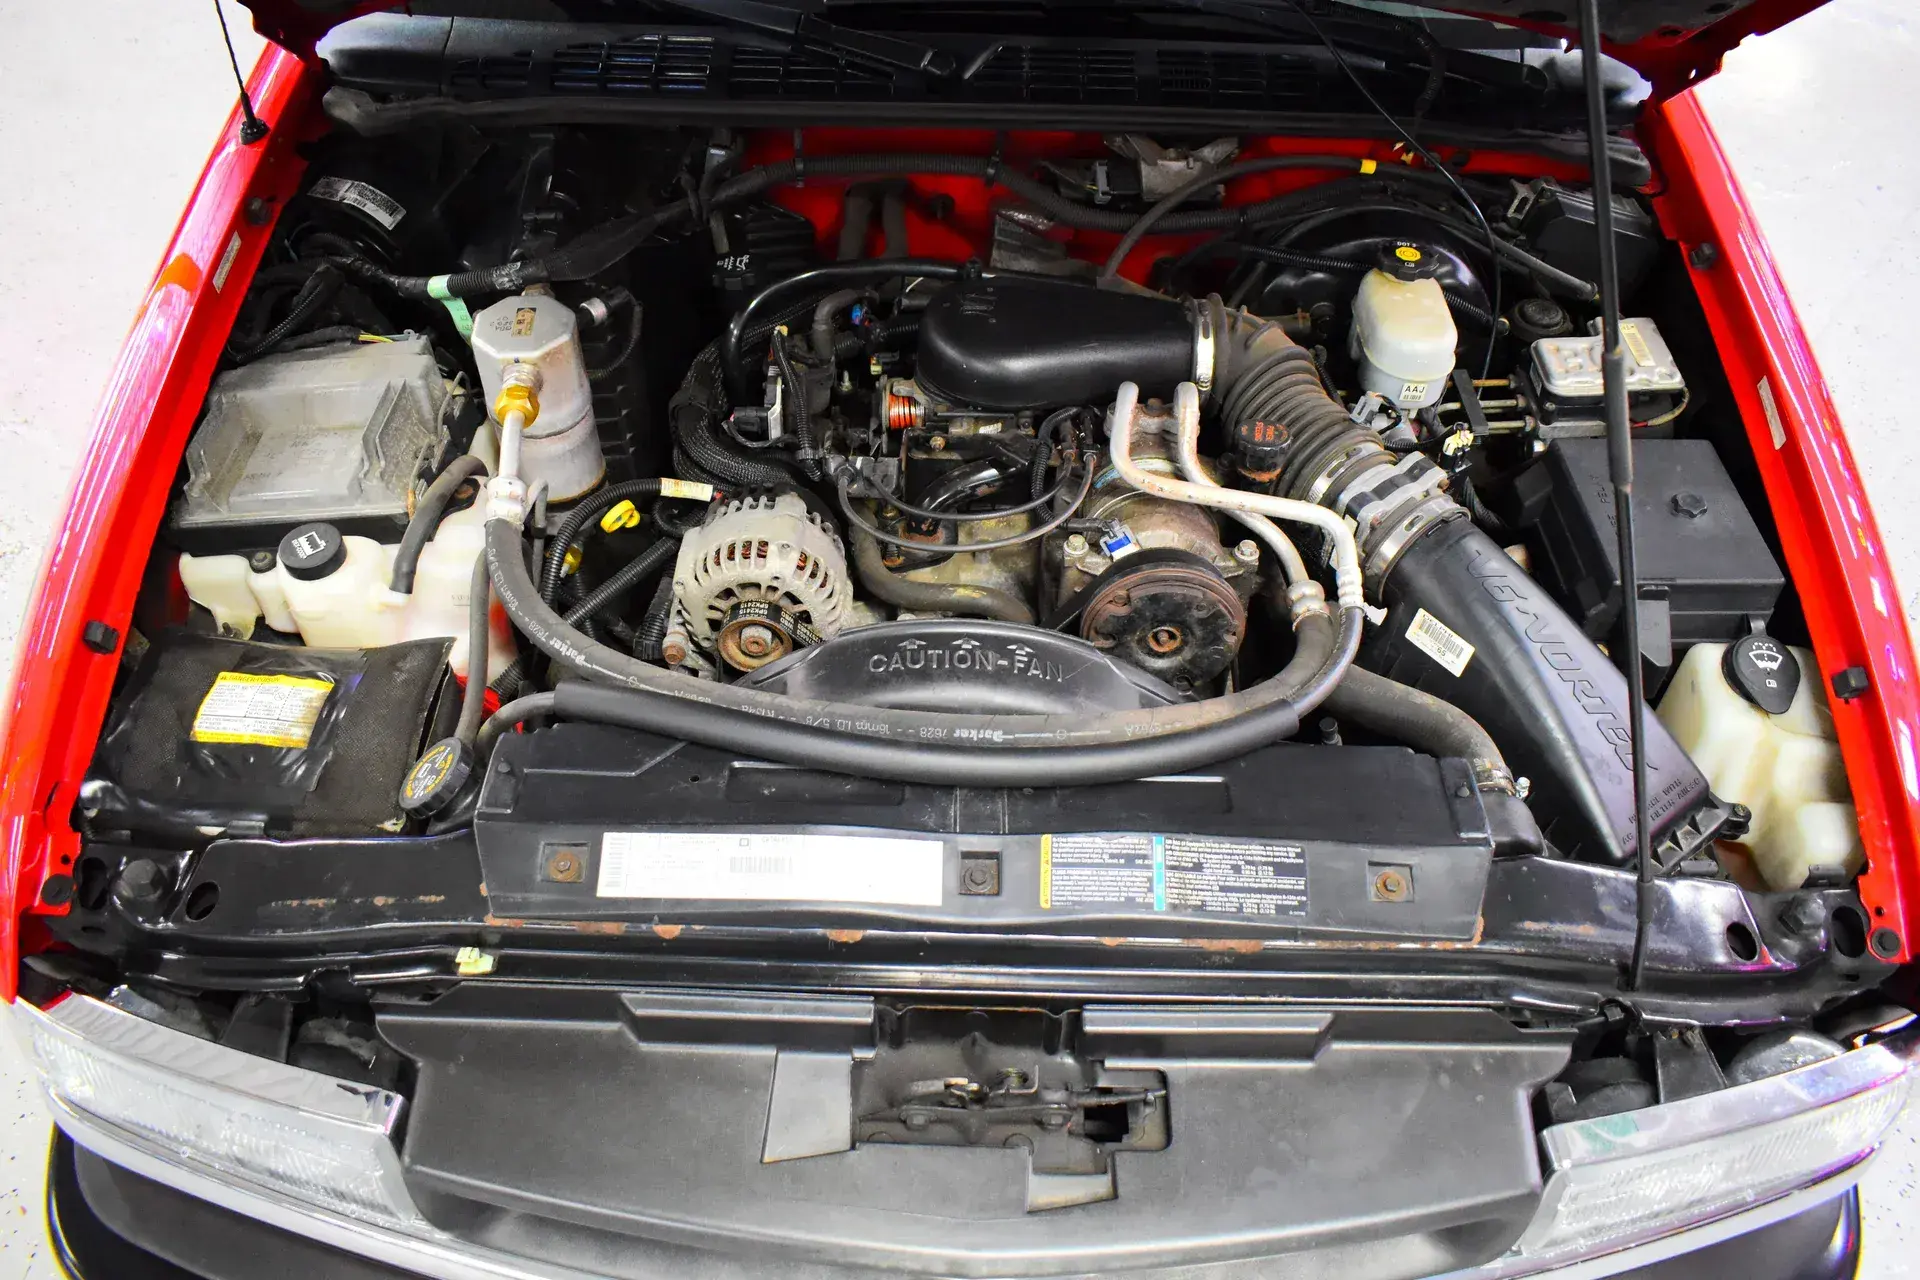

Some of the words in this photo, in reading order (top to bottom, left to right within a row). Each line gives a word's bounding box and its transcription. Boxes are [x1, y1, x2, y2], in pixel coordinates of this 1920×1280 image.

[549, 636, 587, 665] Parker
[1436, 646, 1446, 657] 65
[919, 726, 948, 739] 7628
[953, 727, 1004, 743] Parker
